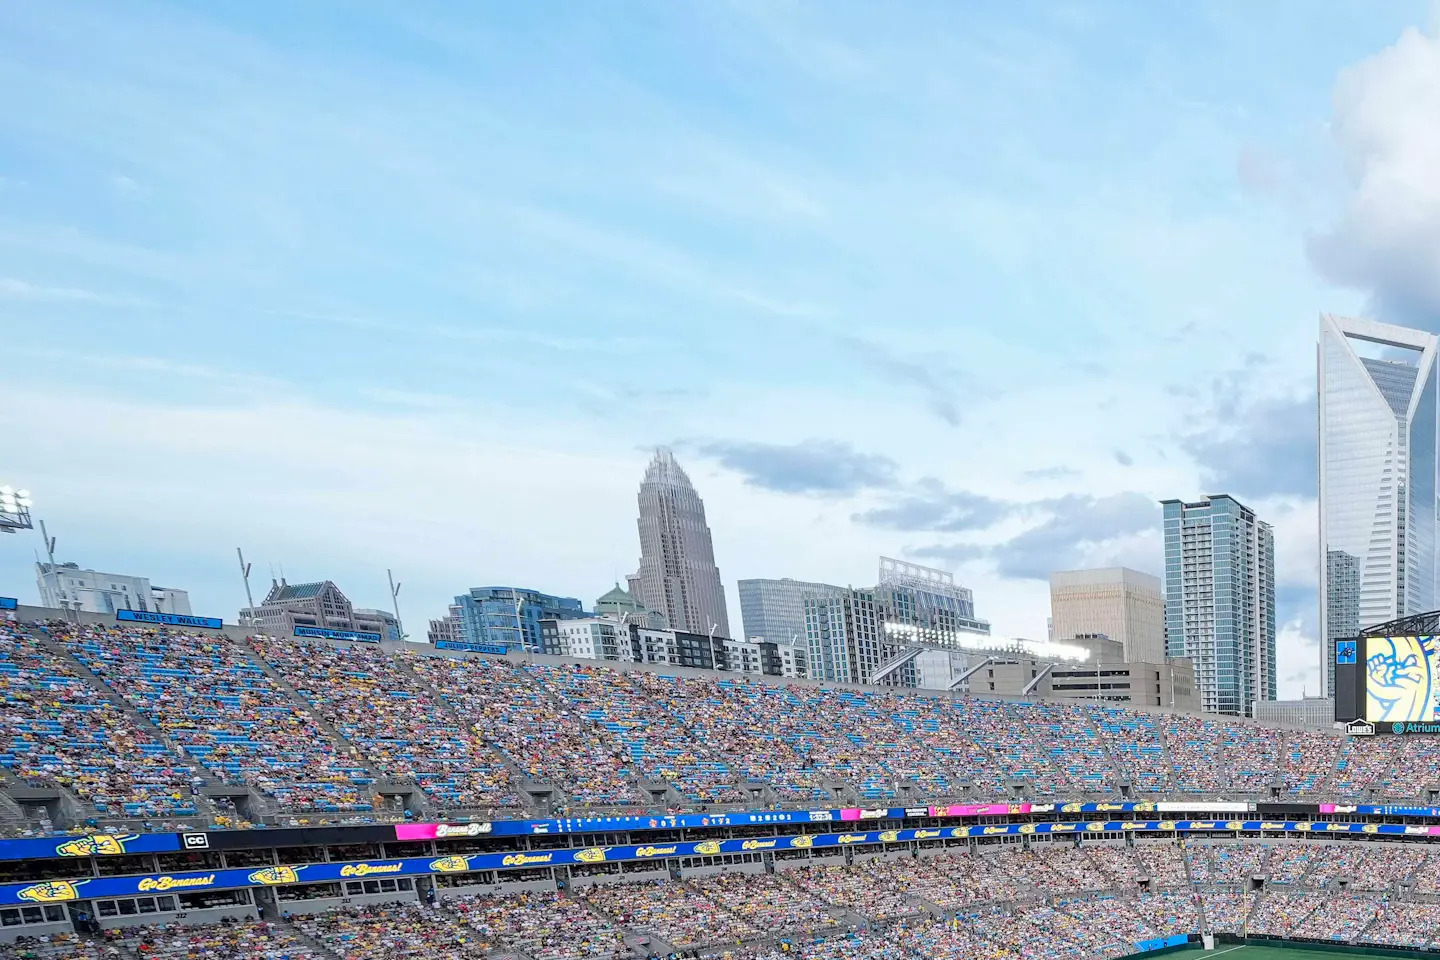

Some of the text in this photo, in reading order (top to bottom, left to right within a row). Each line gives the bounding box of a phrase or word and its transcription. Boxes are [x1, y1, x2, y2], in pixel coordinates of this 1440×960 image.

[133, 612, 209, 626] WESLEY WALLS
[298, 627, 330, 637] MUHSIN
[1347, 724, 1373, 733] LOWE'S
[1405, 722, 1440, 733] Atrium
[436, 822, 492, 837] Banana Ball
[340, 862, 403, 877] Go Bananas!
[138, 874, 216, 891] Go Bananas!
